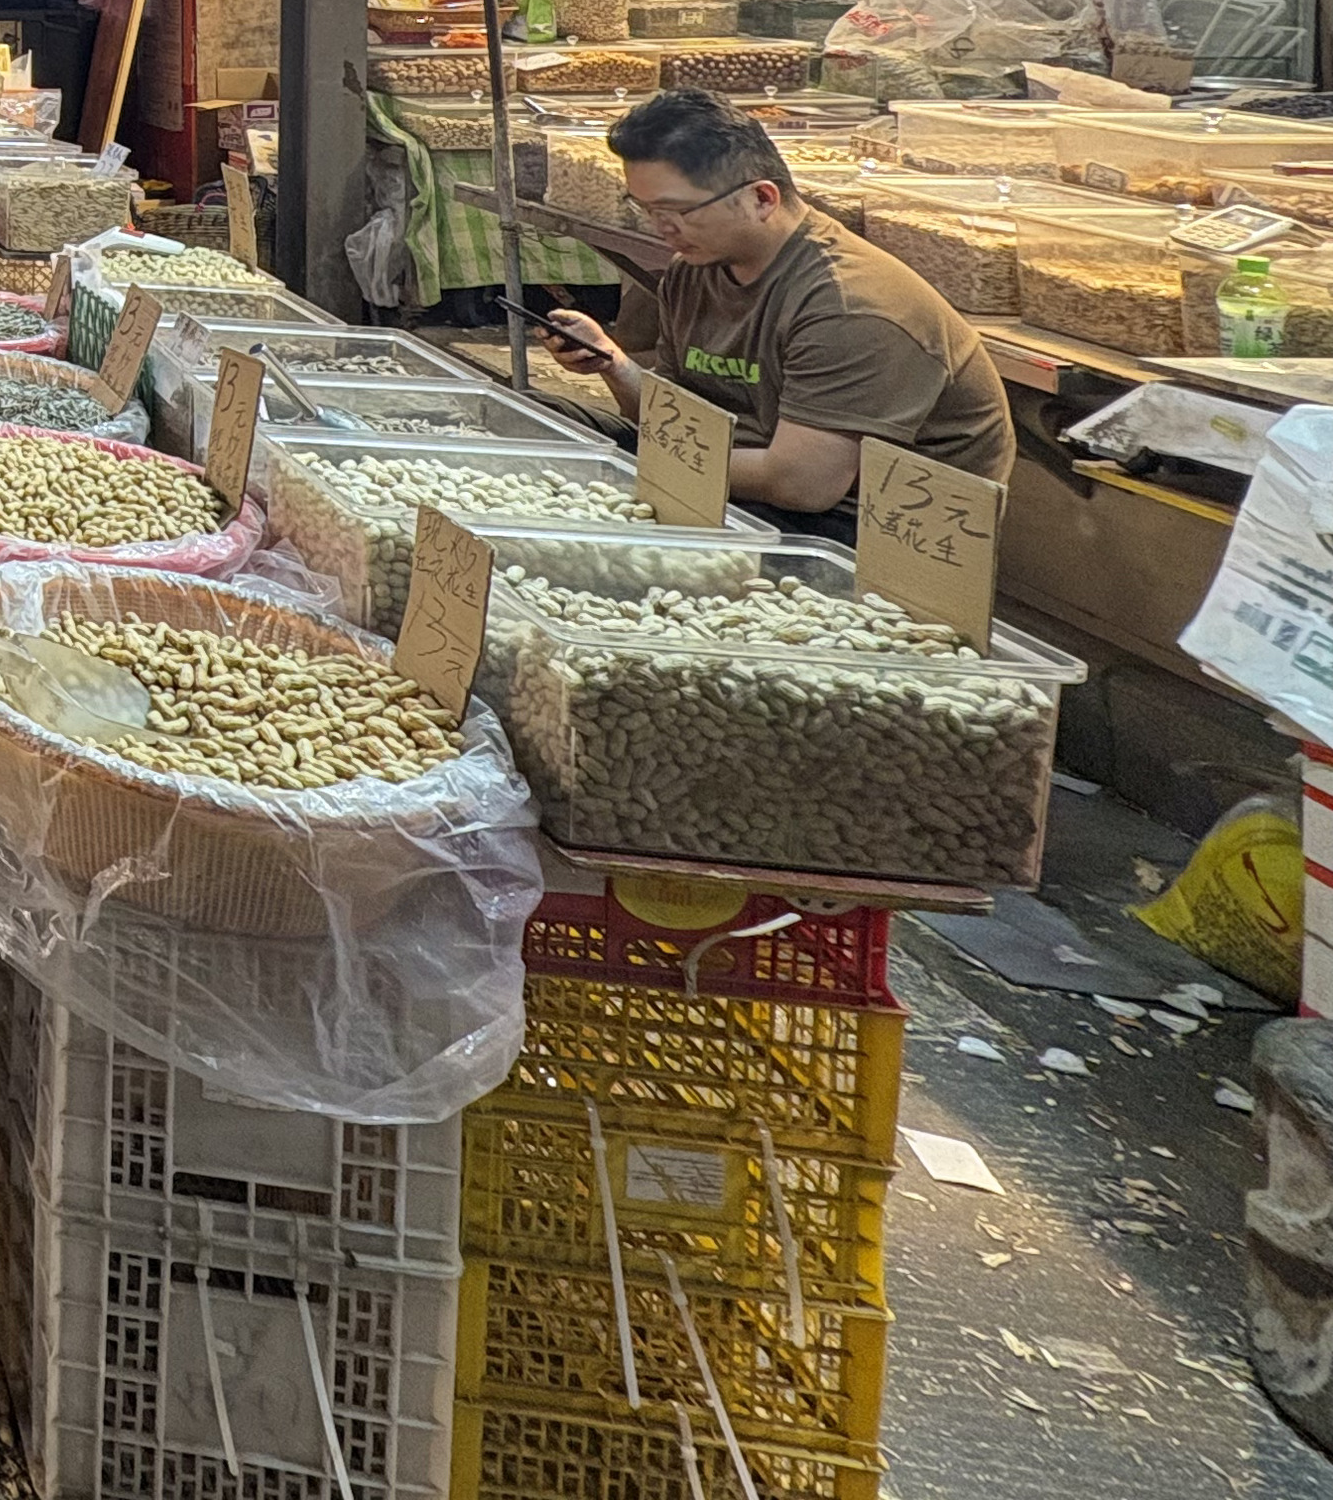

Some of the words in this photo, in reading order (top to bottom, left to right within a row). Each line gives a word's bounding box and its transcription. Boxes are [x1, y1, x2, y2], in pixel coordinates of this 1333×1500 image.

[648, 384, 710, 451] 13元
[860, 492, 963, 568] 水煮花生
[879, 457, 991, 540] 13元
